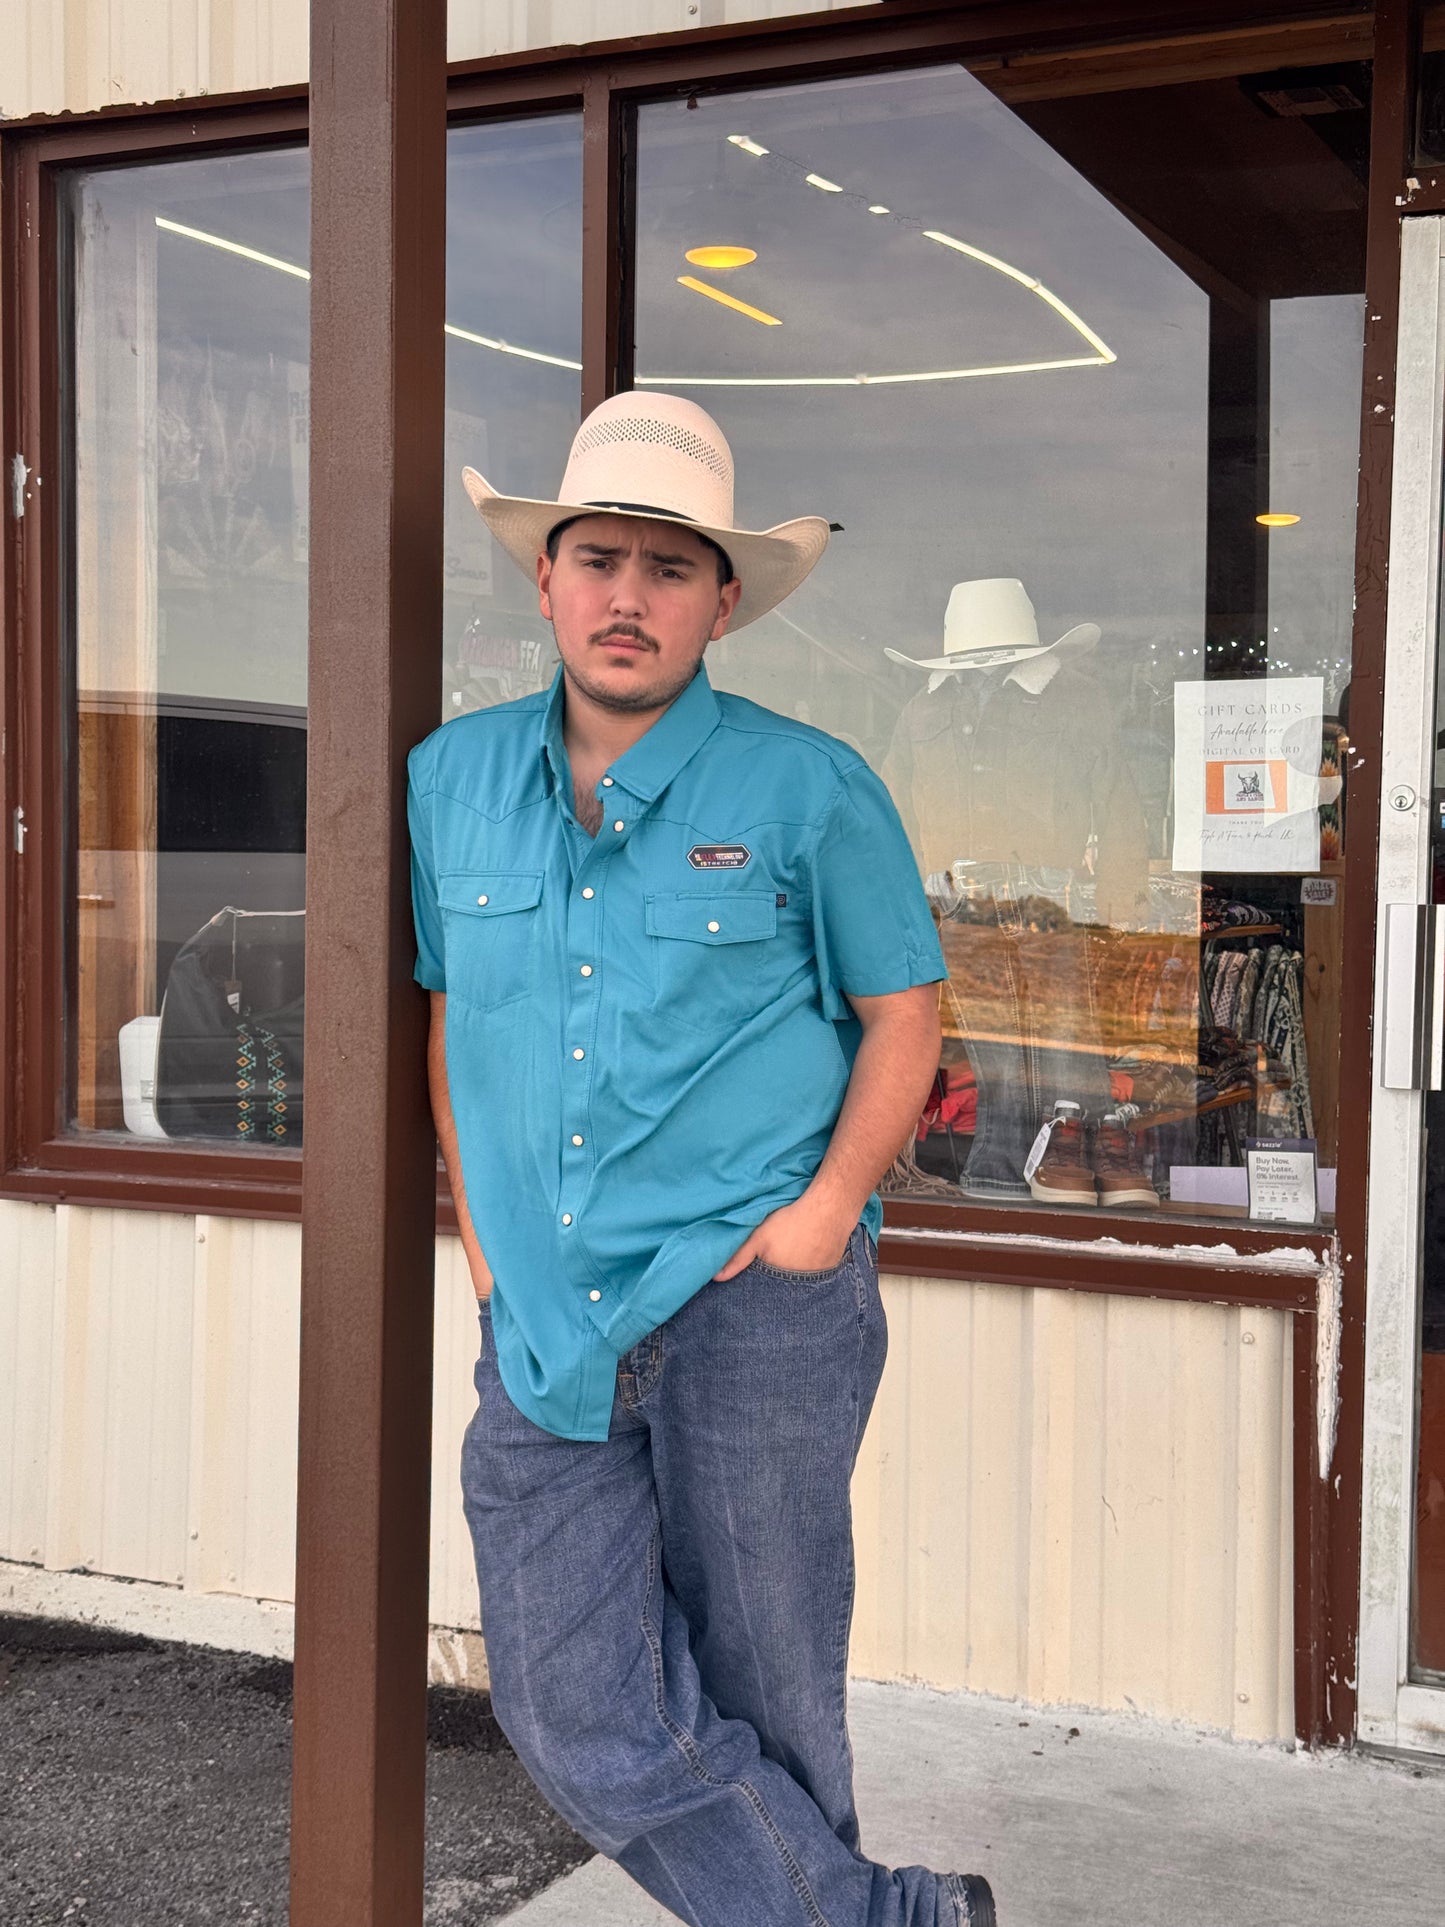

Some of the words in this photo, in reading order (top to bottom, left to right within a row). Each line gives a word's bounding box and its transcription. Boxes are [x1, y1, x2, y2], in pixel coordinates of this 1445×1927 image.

[1198, 705, 1235, 716] GIFT
[1245, 703, 1303, 715] CARDS
[1209, 721, 1257, 742] Available
[1249, 746, 1265, 754] OR
[1256, 1157, 1270, 1165] Buy
[1256, 1165, 1270, 1173] Pay
